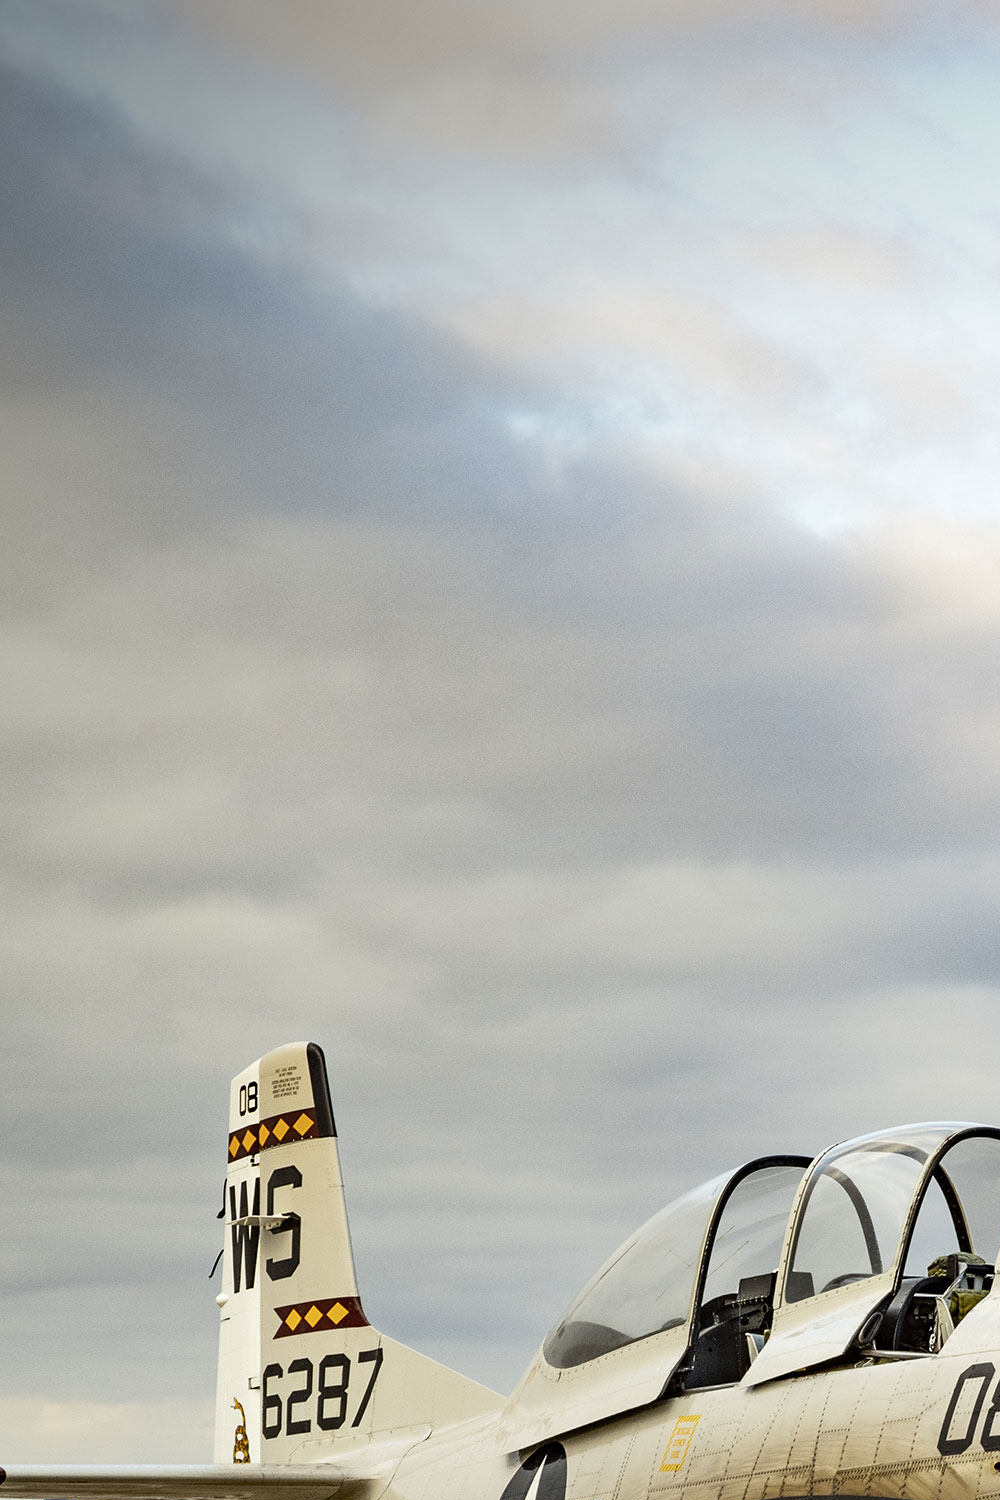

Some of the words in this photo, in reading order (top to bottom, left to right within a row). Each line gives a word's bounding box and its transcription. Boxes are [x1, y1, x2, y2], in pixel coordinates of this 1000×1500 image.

[239, 1081, 258, 1117] 08
[229, 1164, 303, 1294] WS
[262, 1347, 384, 1440] 6287
